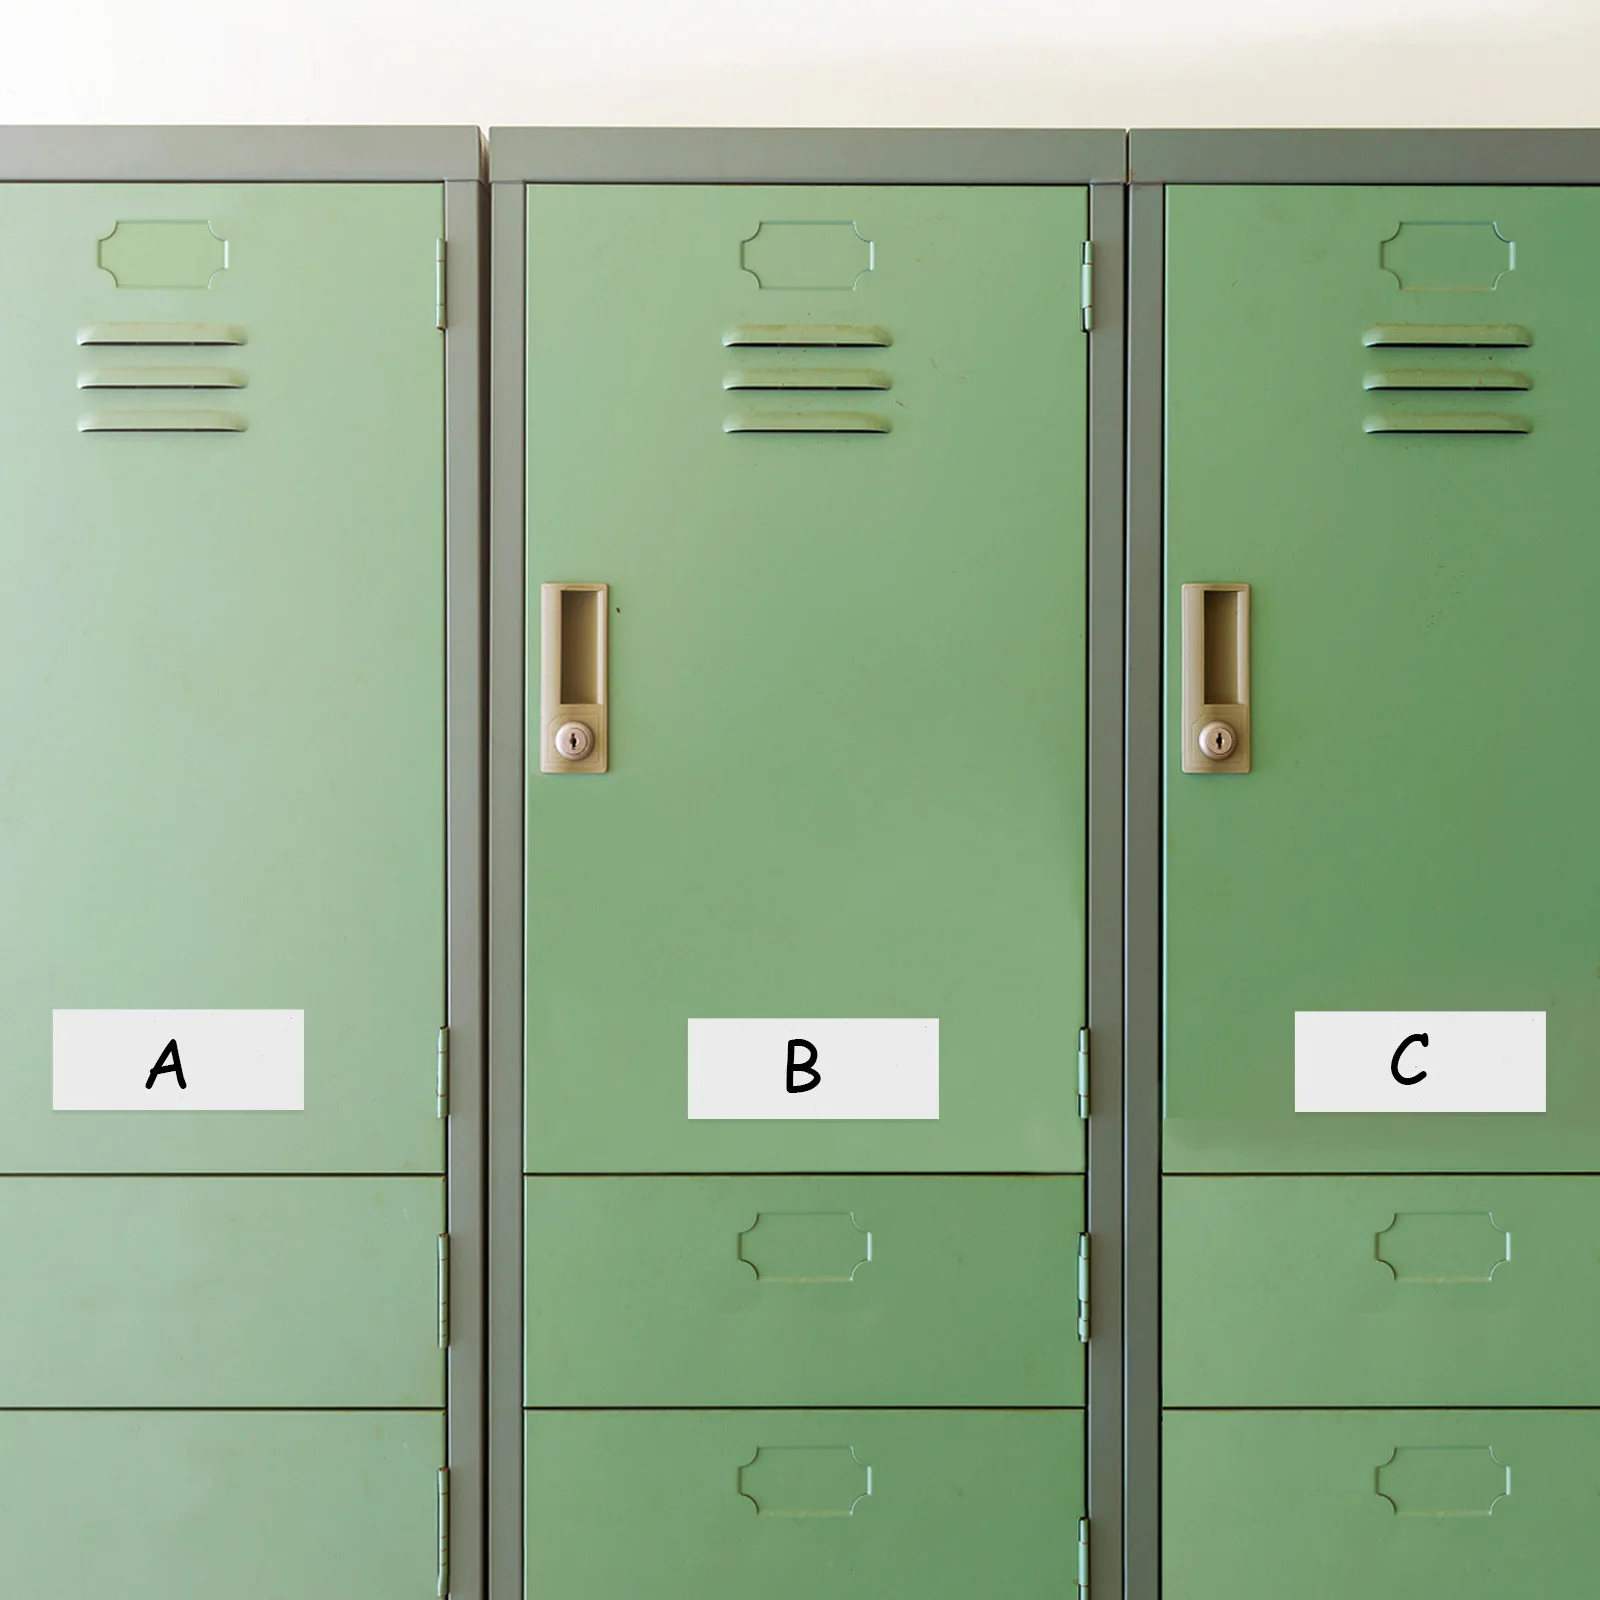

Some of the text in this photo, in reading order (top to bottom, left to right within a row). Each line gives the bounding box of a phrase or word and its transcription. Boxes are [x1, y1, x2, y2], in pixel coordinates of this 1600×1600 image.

[145, 1038, 187, 1090] A
[786, 1038, 822, 1094] B
[1390, 1032, 1429, 1086] C
